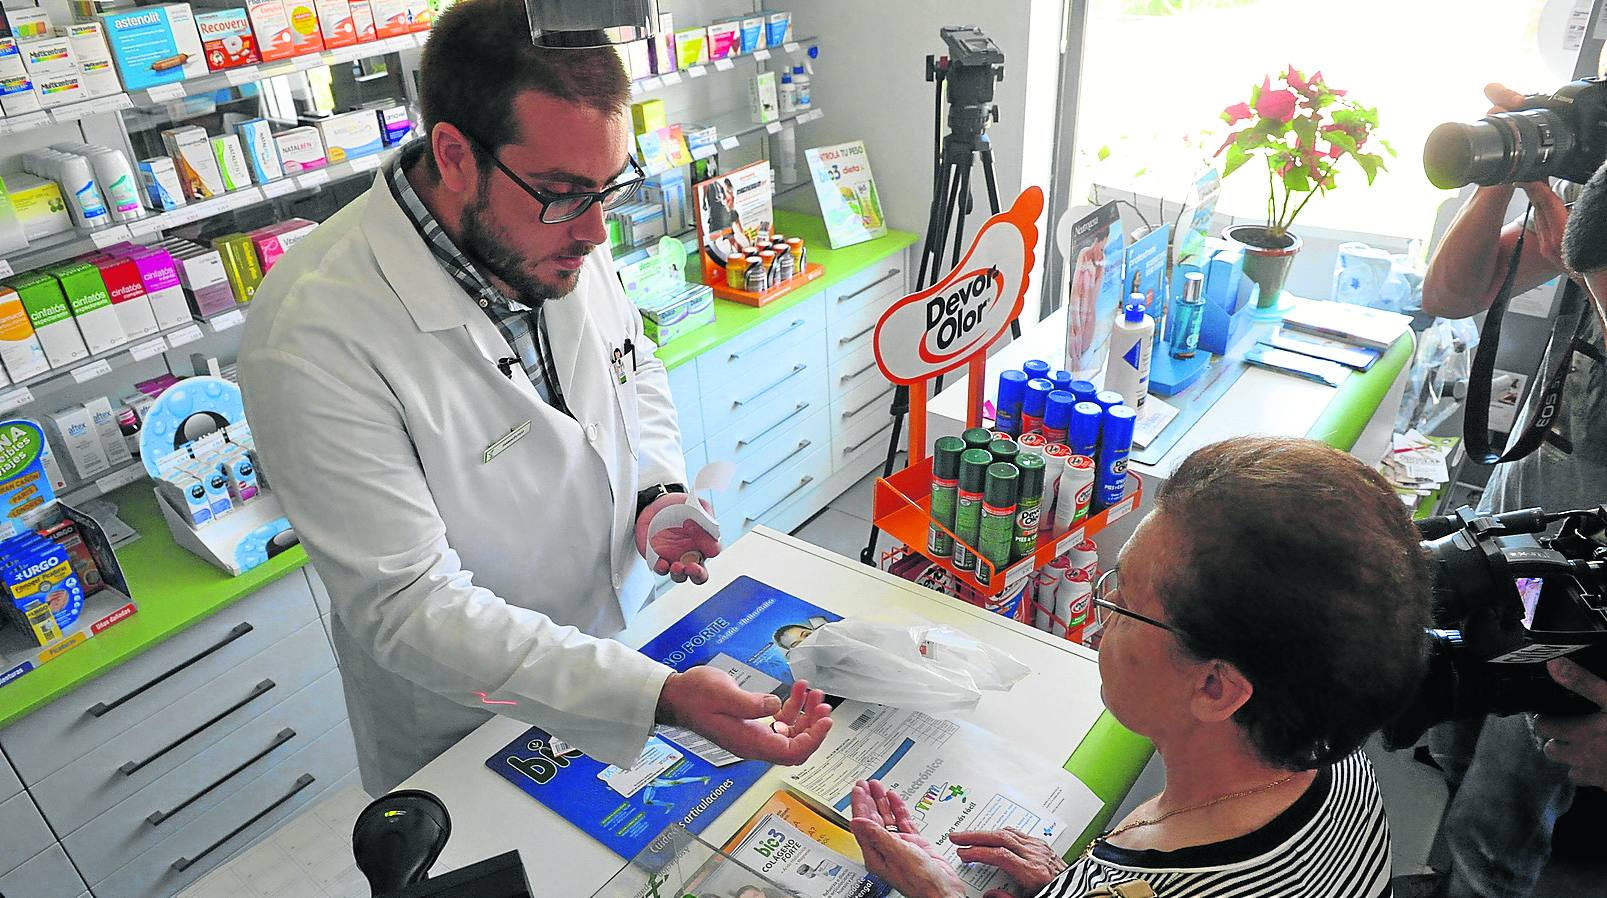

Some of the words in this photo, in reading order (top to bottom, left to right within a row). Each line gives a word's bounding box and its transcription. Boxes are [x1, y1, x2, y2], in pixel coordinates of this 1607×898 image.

[114, 11, 161, 29] astenolit
[200, 18, 248, 34] Recovery
[30, 47, 68, 58] Multicentrum
[41, 78, 78, 89] Multicentrum
[936, 299, 988, 350] Olor
[1536, 390, 1556, 429] EOS
[0, 426, 28, 453] NA
[68, 422, 87, 435] aftex
[23, 556, 59, 579] URGO
[682, 616, 731, 654] FORTE
[900, 757, 945, 802] electrónica
[684, 778, 735, 824] articulaciones
[964, 801, 977, 819] fácil
[753, 828, 786, 858] bio3
[781, 841, 802, 863] FORTE
[762, 839, 795, 873] COLÁGENO
[855, 880, 874, 898] tenga!
